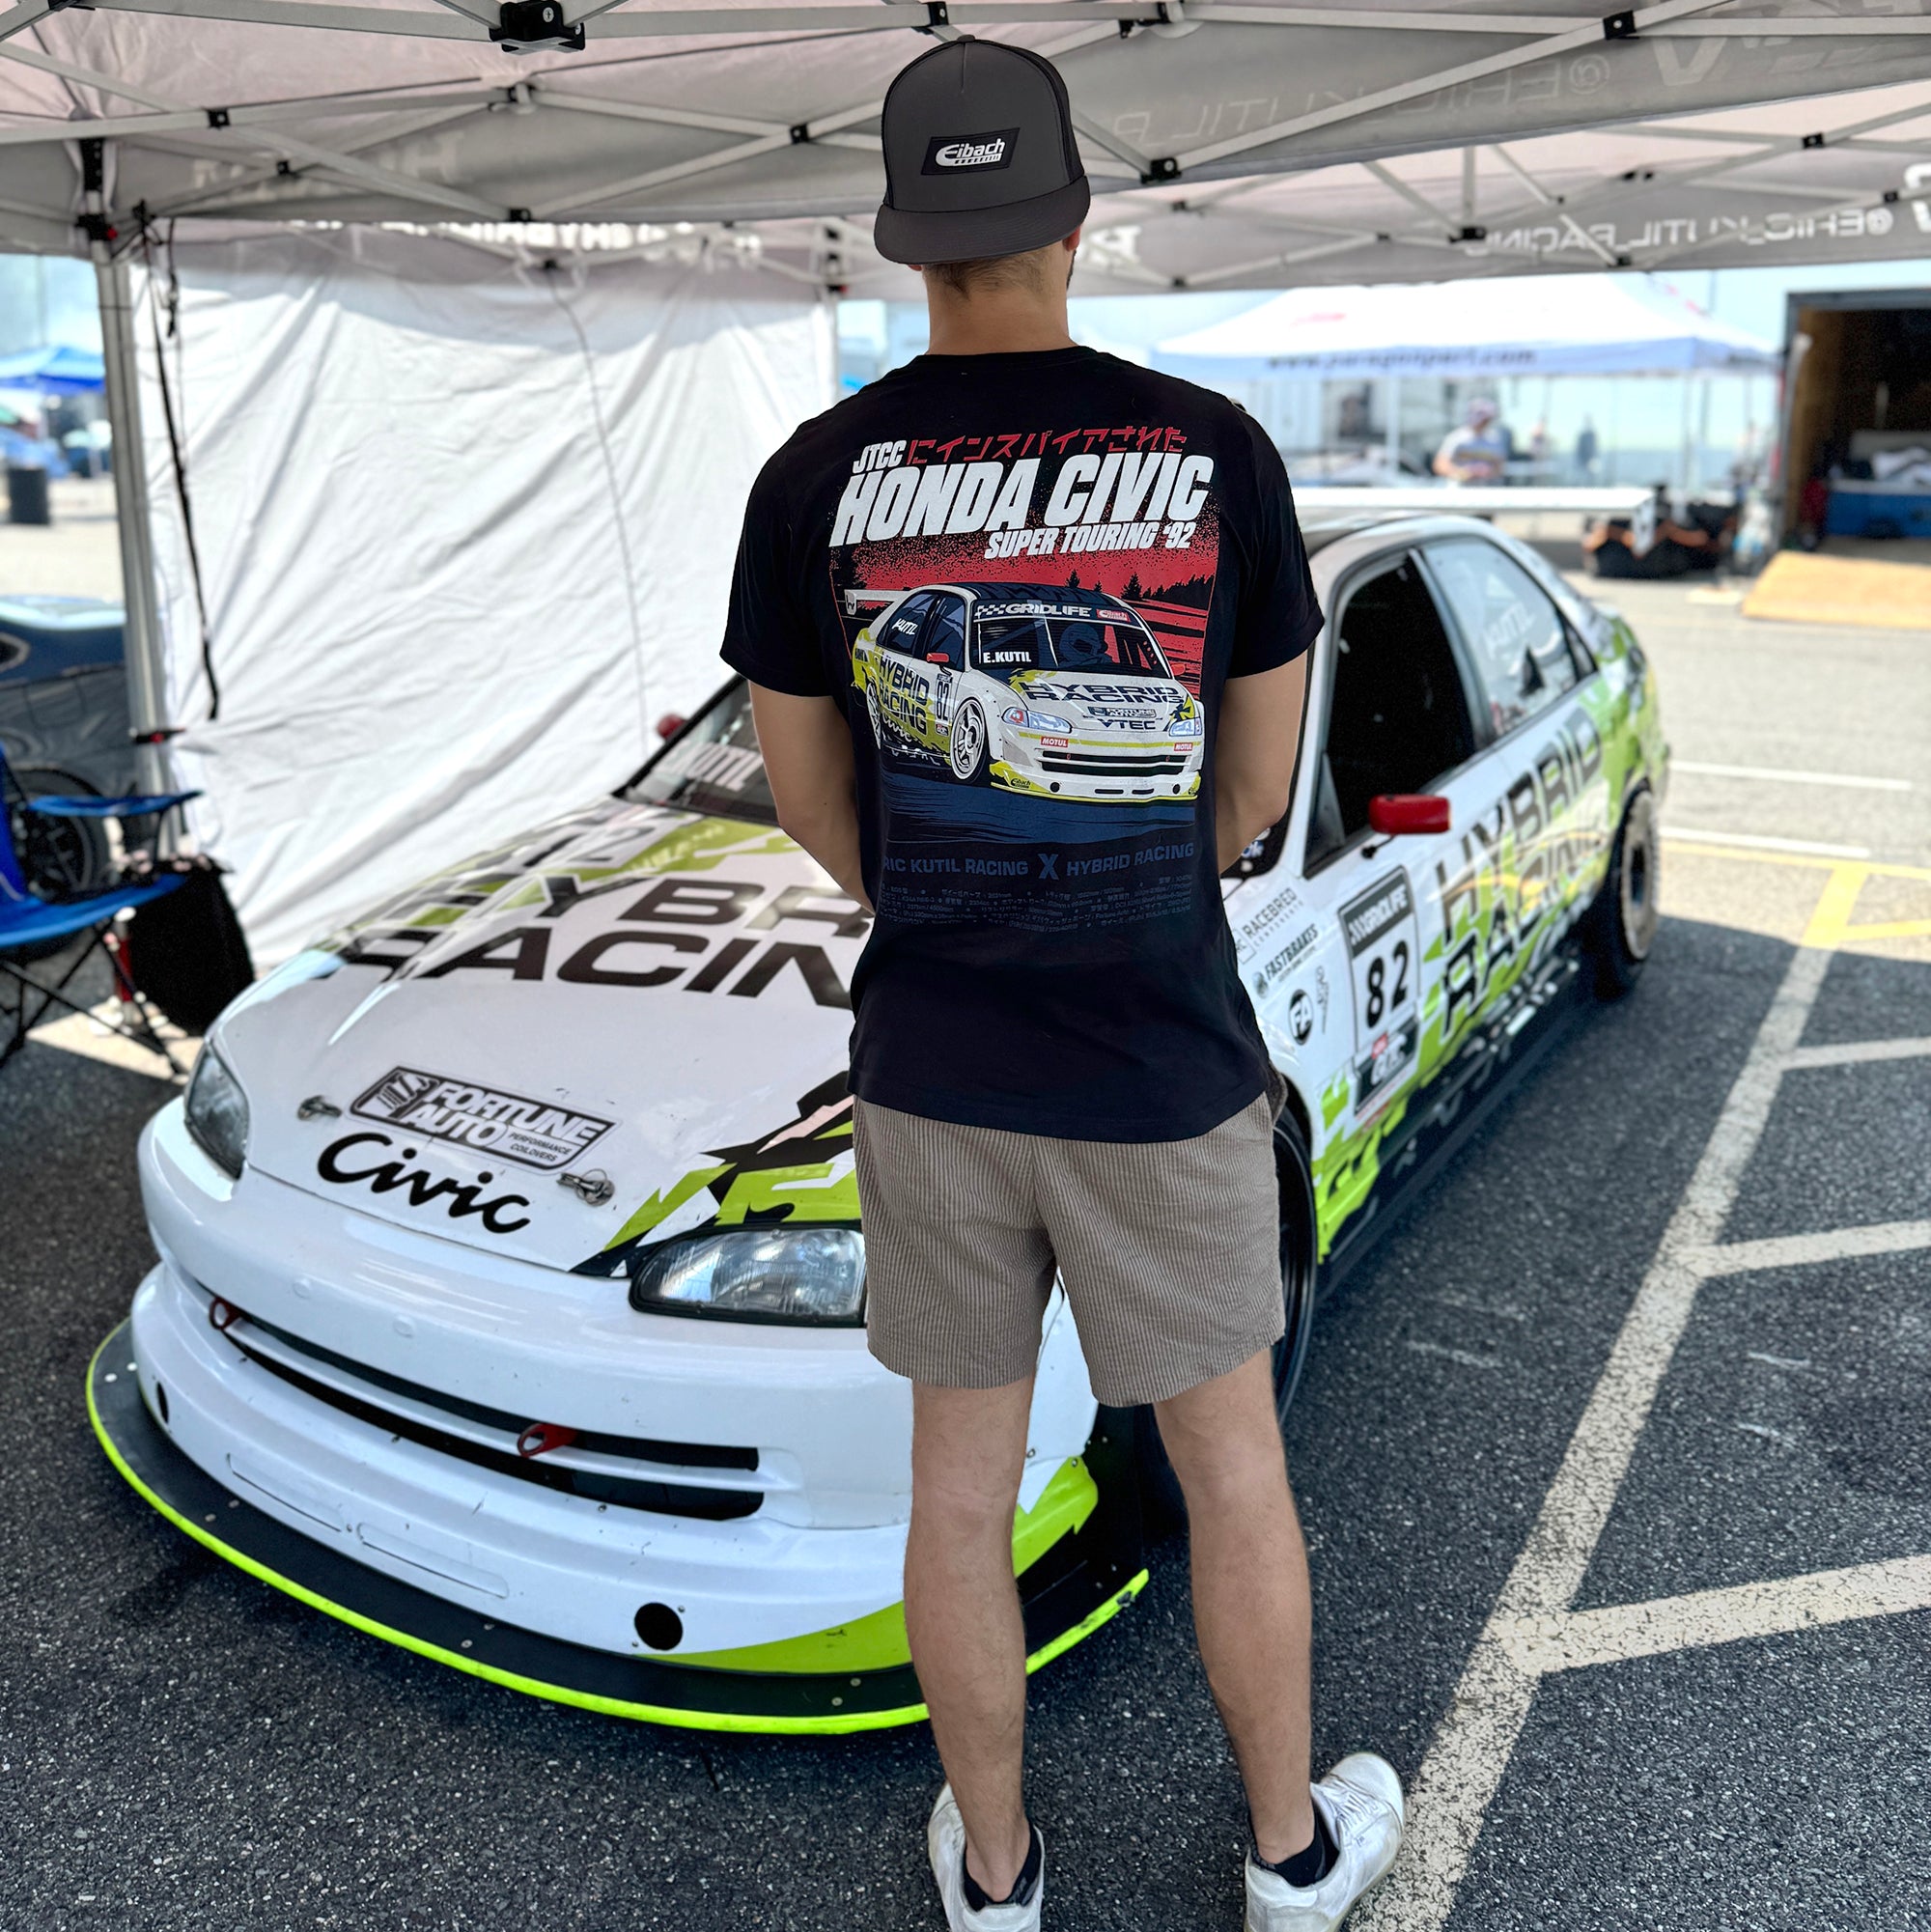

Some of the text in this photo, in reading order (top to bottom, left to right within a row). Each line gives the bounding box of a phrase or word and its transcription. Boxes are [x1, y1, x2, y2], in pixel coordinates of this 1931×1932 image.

[935, 137, 1006, 167] Eibach
[852, 425, 1189, 474] JTCC にインスパイアされた
[828, 451, 1215, 547] HONDA CIVIC
[984, 528, 1060, 560] SUPER
[1060, 523, 1161, 554] TOURING
[892, 618, 918, 635] KUTIL
[1005, 602, 1093, 617] GRIDLIFE
[983, 651, 1032, 663] E.KUTIL
[879, 657, 930, 706] HYBRID
[1020, 682, 1180, 695] HYBRID
[1024, 690, 1186, 704] RACING
[880, 680, 927, 736] RACING
[1097, 717, 1157, 730] VTEC
[1042, 738, 1068, 747] MOTUL
[1435, 706, 1602, 945] HYBRID
[883, 842, 1194, 881] RIC KUTIL RACING X HYBRID RACING
[381, 871, 872, 939] HYBR
[1242, 887, 1298, 939] RACEBRED
[317, 924, 859, 1011] RACIN
[1265, 923, 1319, 982] FASTBRAKES
[1366, 939, 1409, 1028] 82
[398, 1103, 508, 1147] AUTO
[422, 1079, 608, 1147] FORTUNE
[508, 1132, 573, 1156] PERFORMANCE
[509, 1142, 559, 1162] COILOVERS
[317, 1132, 530, 1234] Civic
